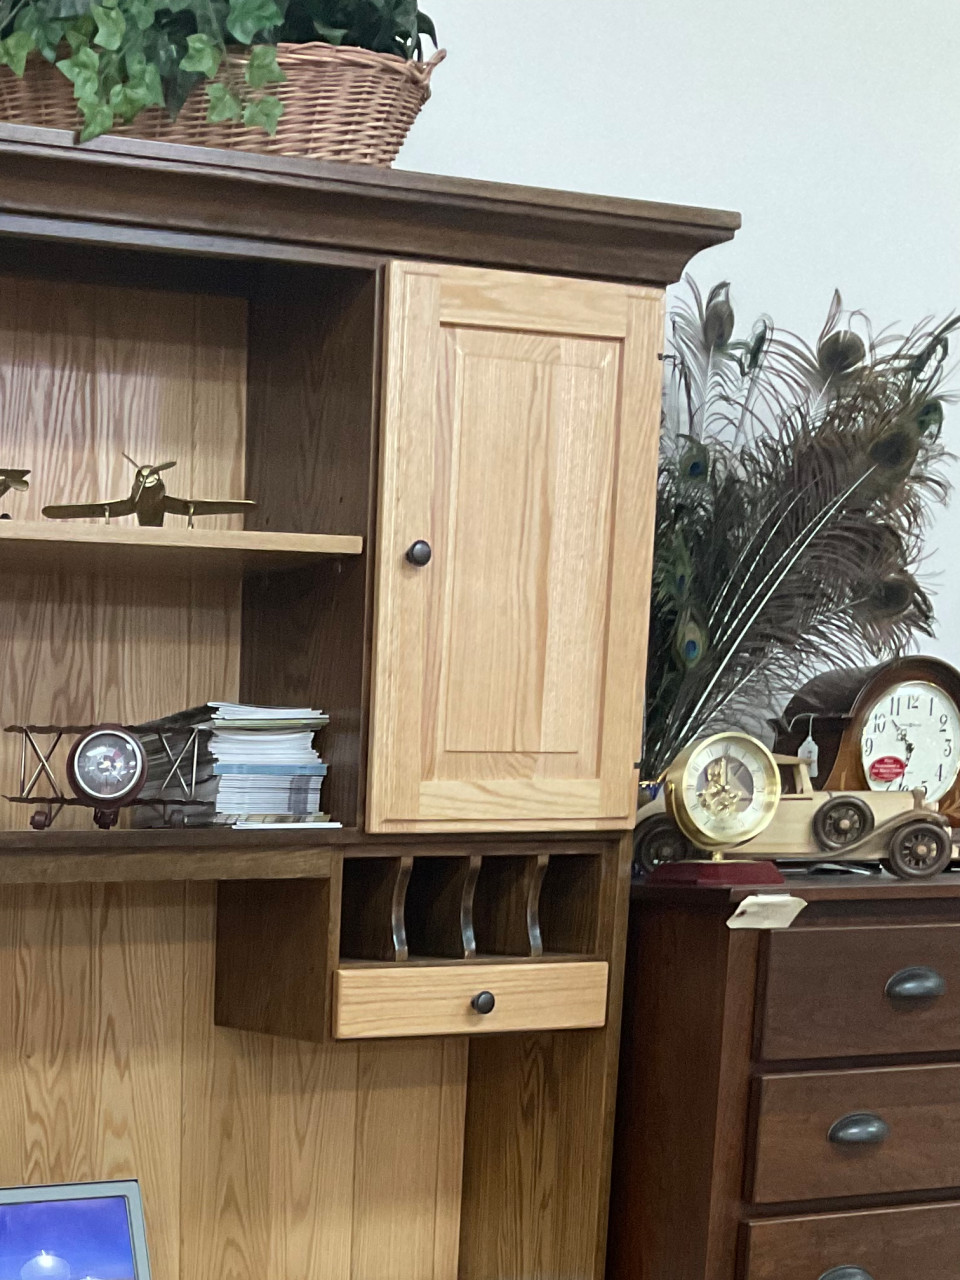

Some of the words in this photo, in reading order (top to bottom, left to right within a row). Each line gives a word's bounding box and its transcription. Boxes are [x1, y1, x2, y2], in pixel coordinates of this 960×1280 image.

[890, 697, 900, 716] 11
[907, 694, 919, 710] 12
[874, 713, 886, 733] 10
[939, 714, 949, 732] 2
[865, 737, 873, 757] 9
[943, 739, 952, 758] 3
[934, 763, 943, 782] 4
